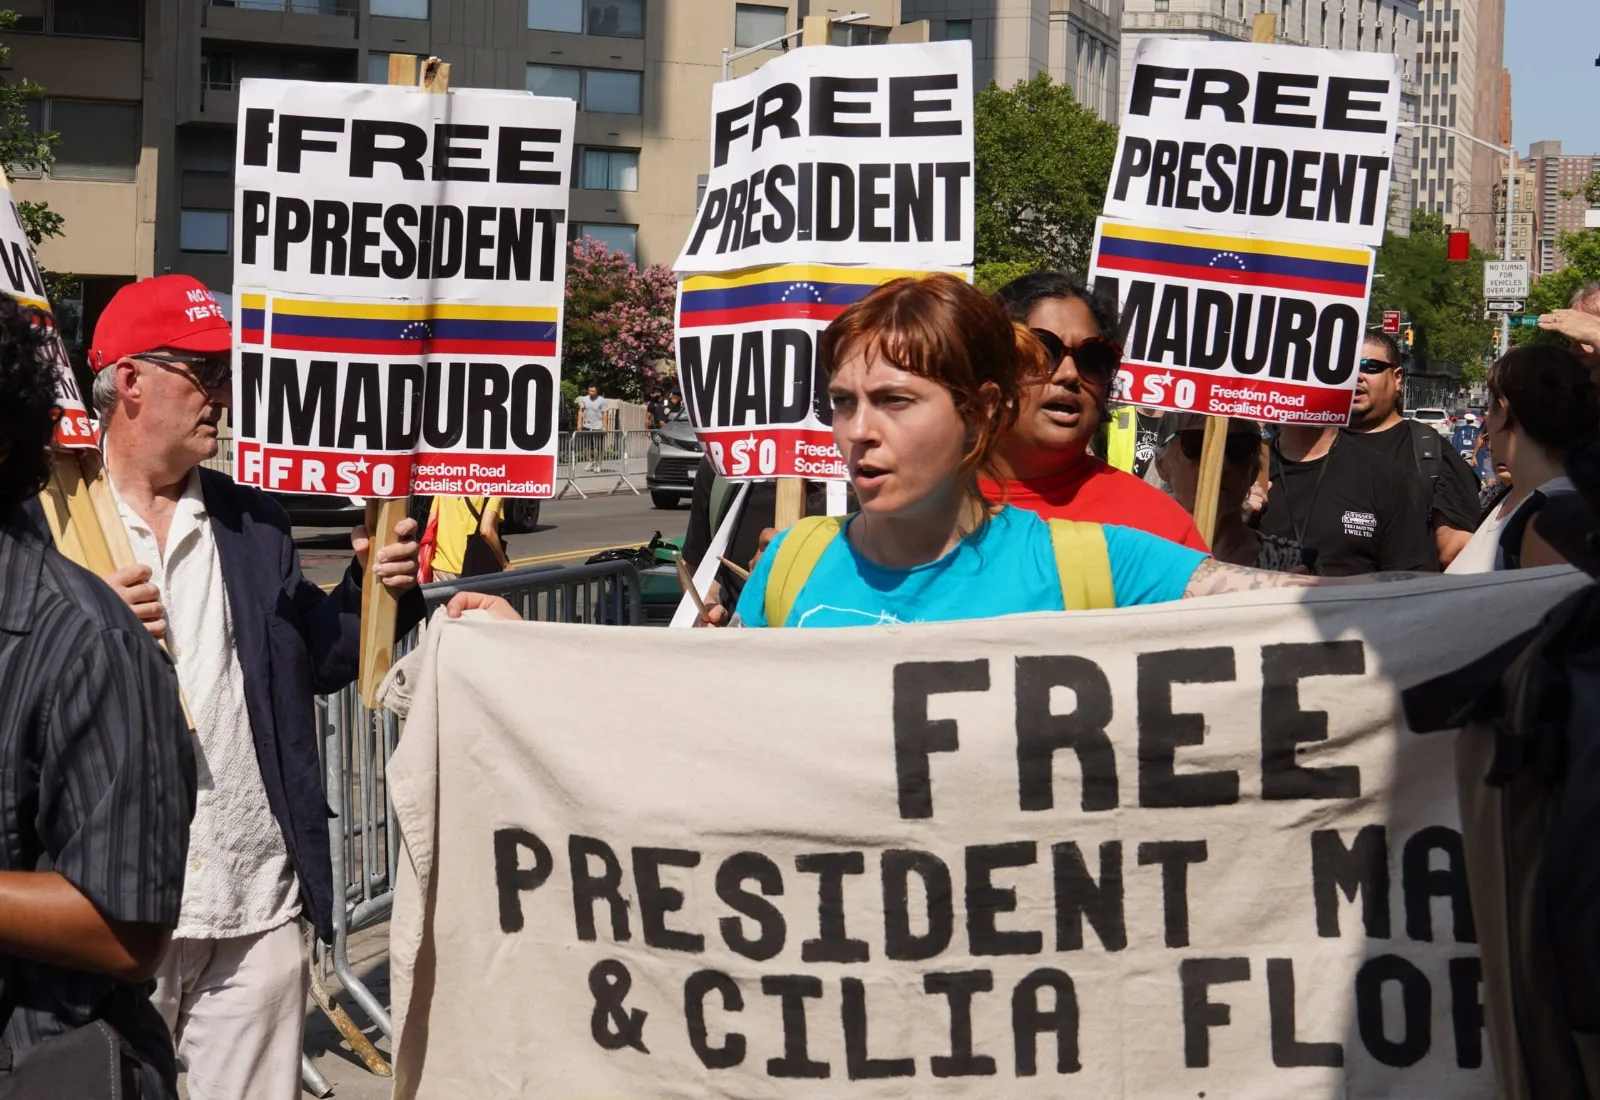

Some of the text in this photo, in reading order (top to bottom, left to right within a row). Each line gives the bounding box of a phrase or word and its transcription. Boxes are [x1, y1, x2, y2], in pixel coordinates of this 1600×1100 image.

[714, 74, 963, 168] FREE
[1129, 64, 1390, 134] FREE
[277, 114, 562, 185] FREE
[1113, 136, 1390, 226] PRESIDENT
[273, 196, 566, 282] PRESIDENT
[685, 162, 970, 256] PRESIDENT
[185, 306, 210, 322] YES
[186, 289, 205, 302] NO
[1092, 275, 1360, 385] MADURO
[267, 357, 554, 451] MADURO
[680, 329, 833, 428] MAD
[1111, 369, 1196, 409] RSO
[1208, 399, 1346, 422] Socialist Organization
[1210, 384, 1306, 407] Freedom Road
[269, 456, 395, 494] FRSO
[410, 463, 506, 477] Freedom Road
[703, 438, 777, 475] RSO
[794, 440, 844, 457] Freed
[794, 457, 851, 475] Socialis
[409, 479, 551, 495] Socialist Organization
[893, 640, 1366, 818] FREE
[494, 827, 1207, 963] PRESIDENT
[588, 959, 650, 1054] &
[683, 967, 1083, 1081] CILIA
